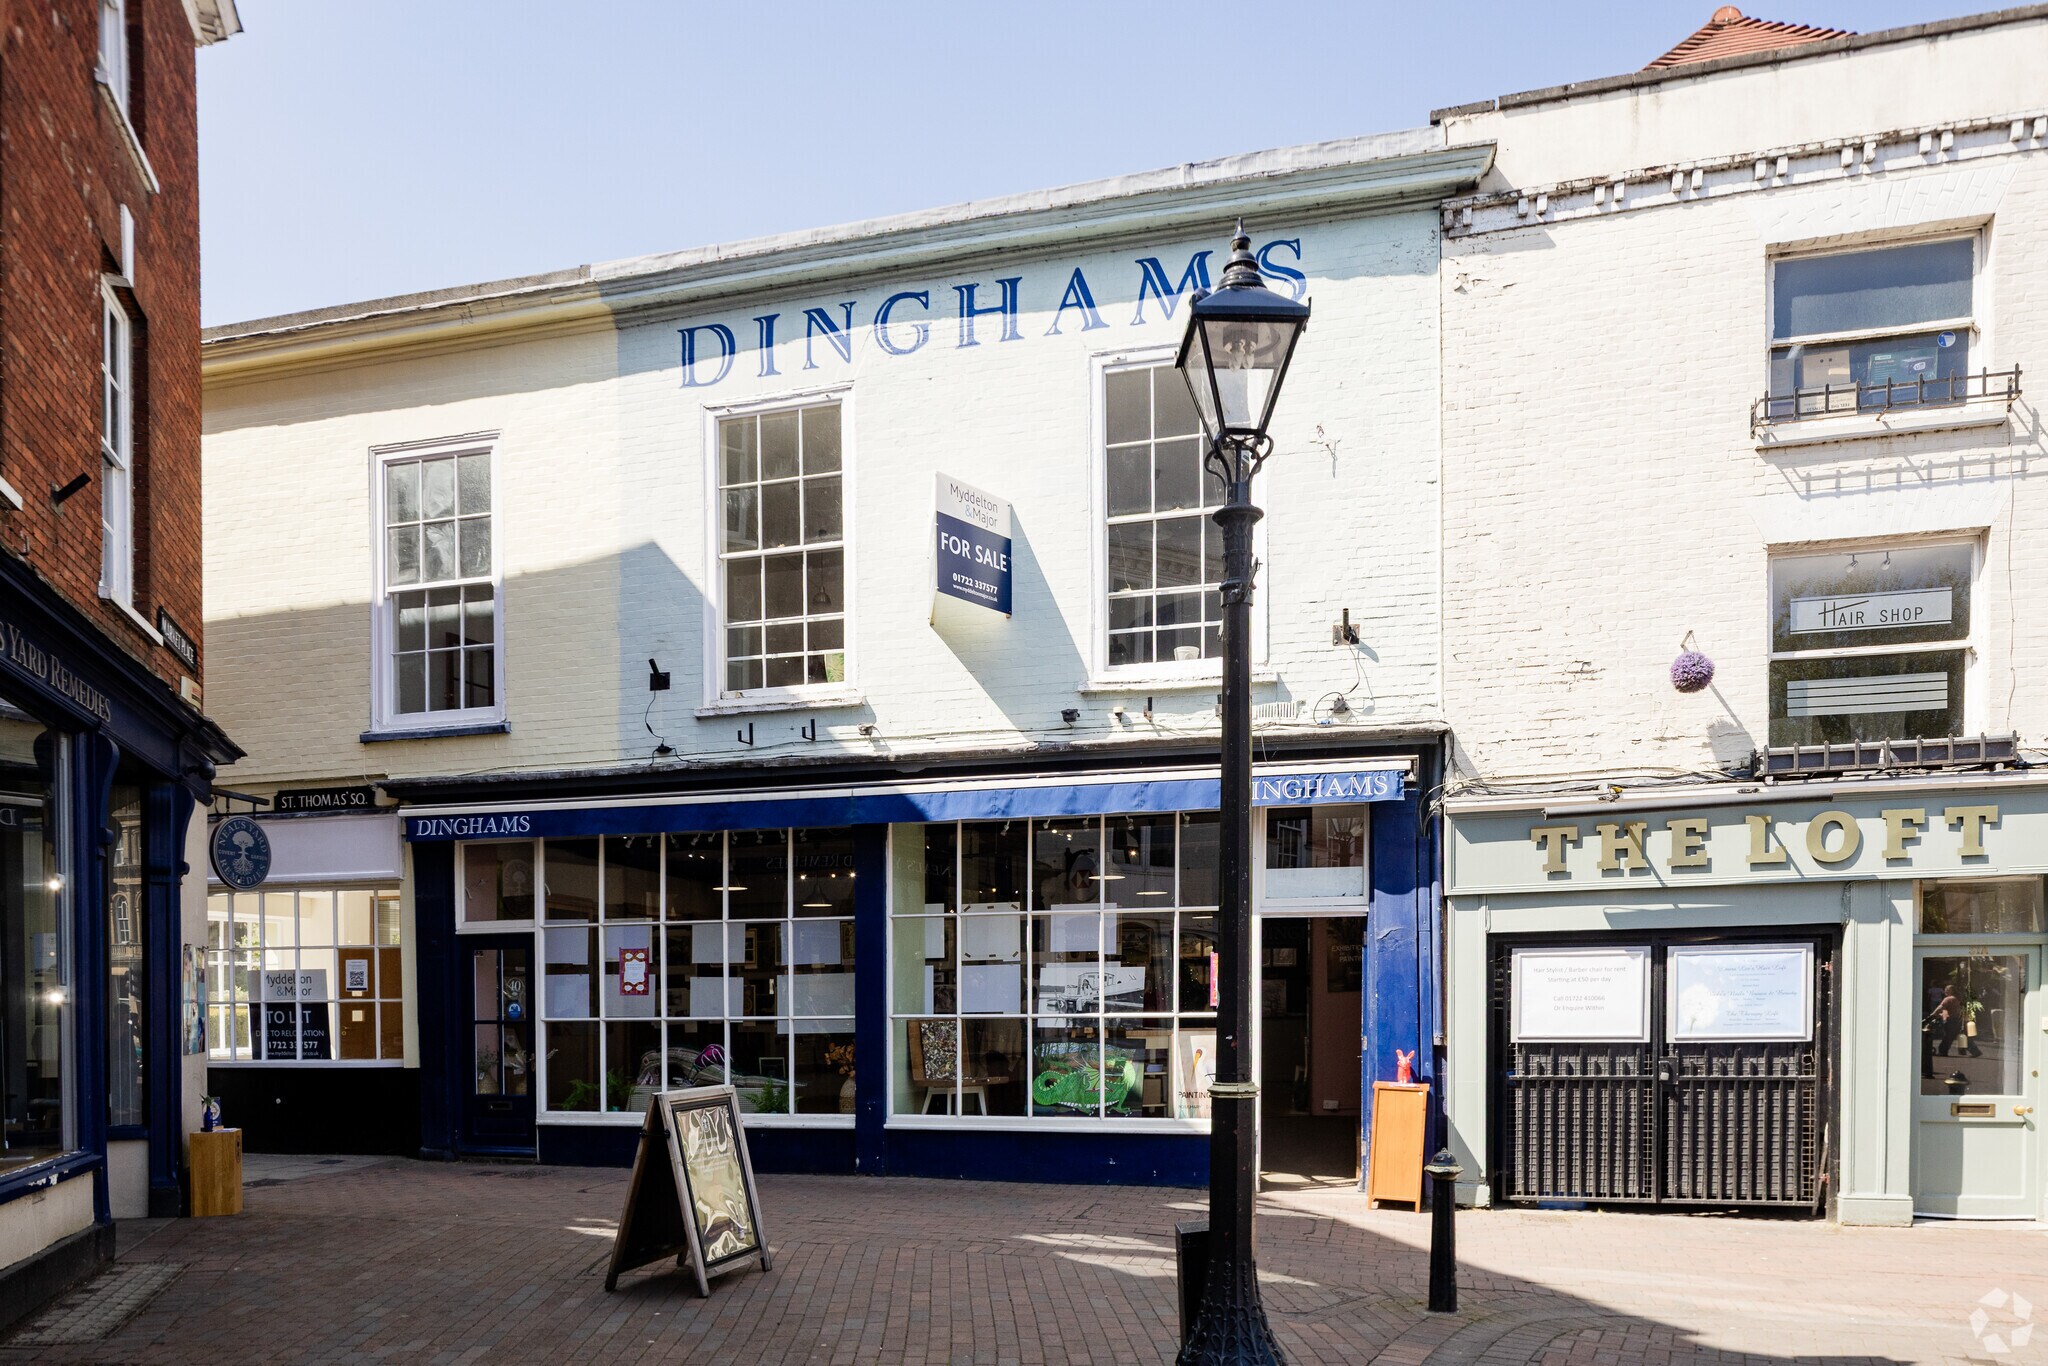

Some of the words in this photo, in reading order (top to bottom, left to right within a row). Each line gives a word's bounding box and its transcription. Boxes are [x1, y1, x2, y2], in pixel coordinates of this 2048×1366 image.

[677, 237, 1306, 389] DINGHAMS
[950, 483, 998, 513] Myddelton
[965, 505, 997, 528] &Major
[941, 531, 971, 559] FOR
[975, 544, 1007, 572] SALE
[952, 572, 973, 587] 01722
[974, 579, 998, 594] 337577
[1879, 606, 1923, 623] SHOP
[162, 616, 181, 650] MARKET
[181, 638, 194, 664] PLACE
[7, 623, 47, 679] YARD
[50, 654, 111, 722] REMEDIES
[1252, 775, 1388, 800] INGHAMS
[281, 796, 296, 809] ST.
[298, 791, 349, 807] THOMAS'
[350, 793, 368, 805] SQ.
[219, 821, 246, 845] NEAL'S
[248, 824, 267, 853] YARD
[416, 815, 530, 836] DINGHAMS
[1530, 818, 1708, 872] THE
[1745, 805, 1999, 865] LOFT
[220, 859, 265, 884] REMEDIES
[266, 973, 312, 987] yddelon
[276, 986, 312, 996] &Maor
[266, 1011, 285, 1024] TO
[289, 1011, 312, 1024] LT
[268, 1041, 287, 1049] 1722
[289, 1041, 318, 1049] 33577
